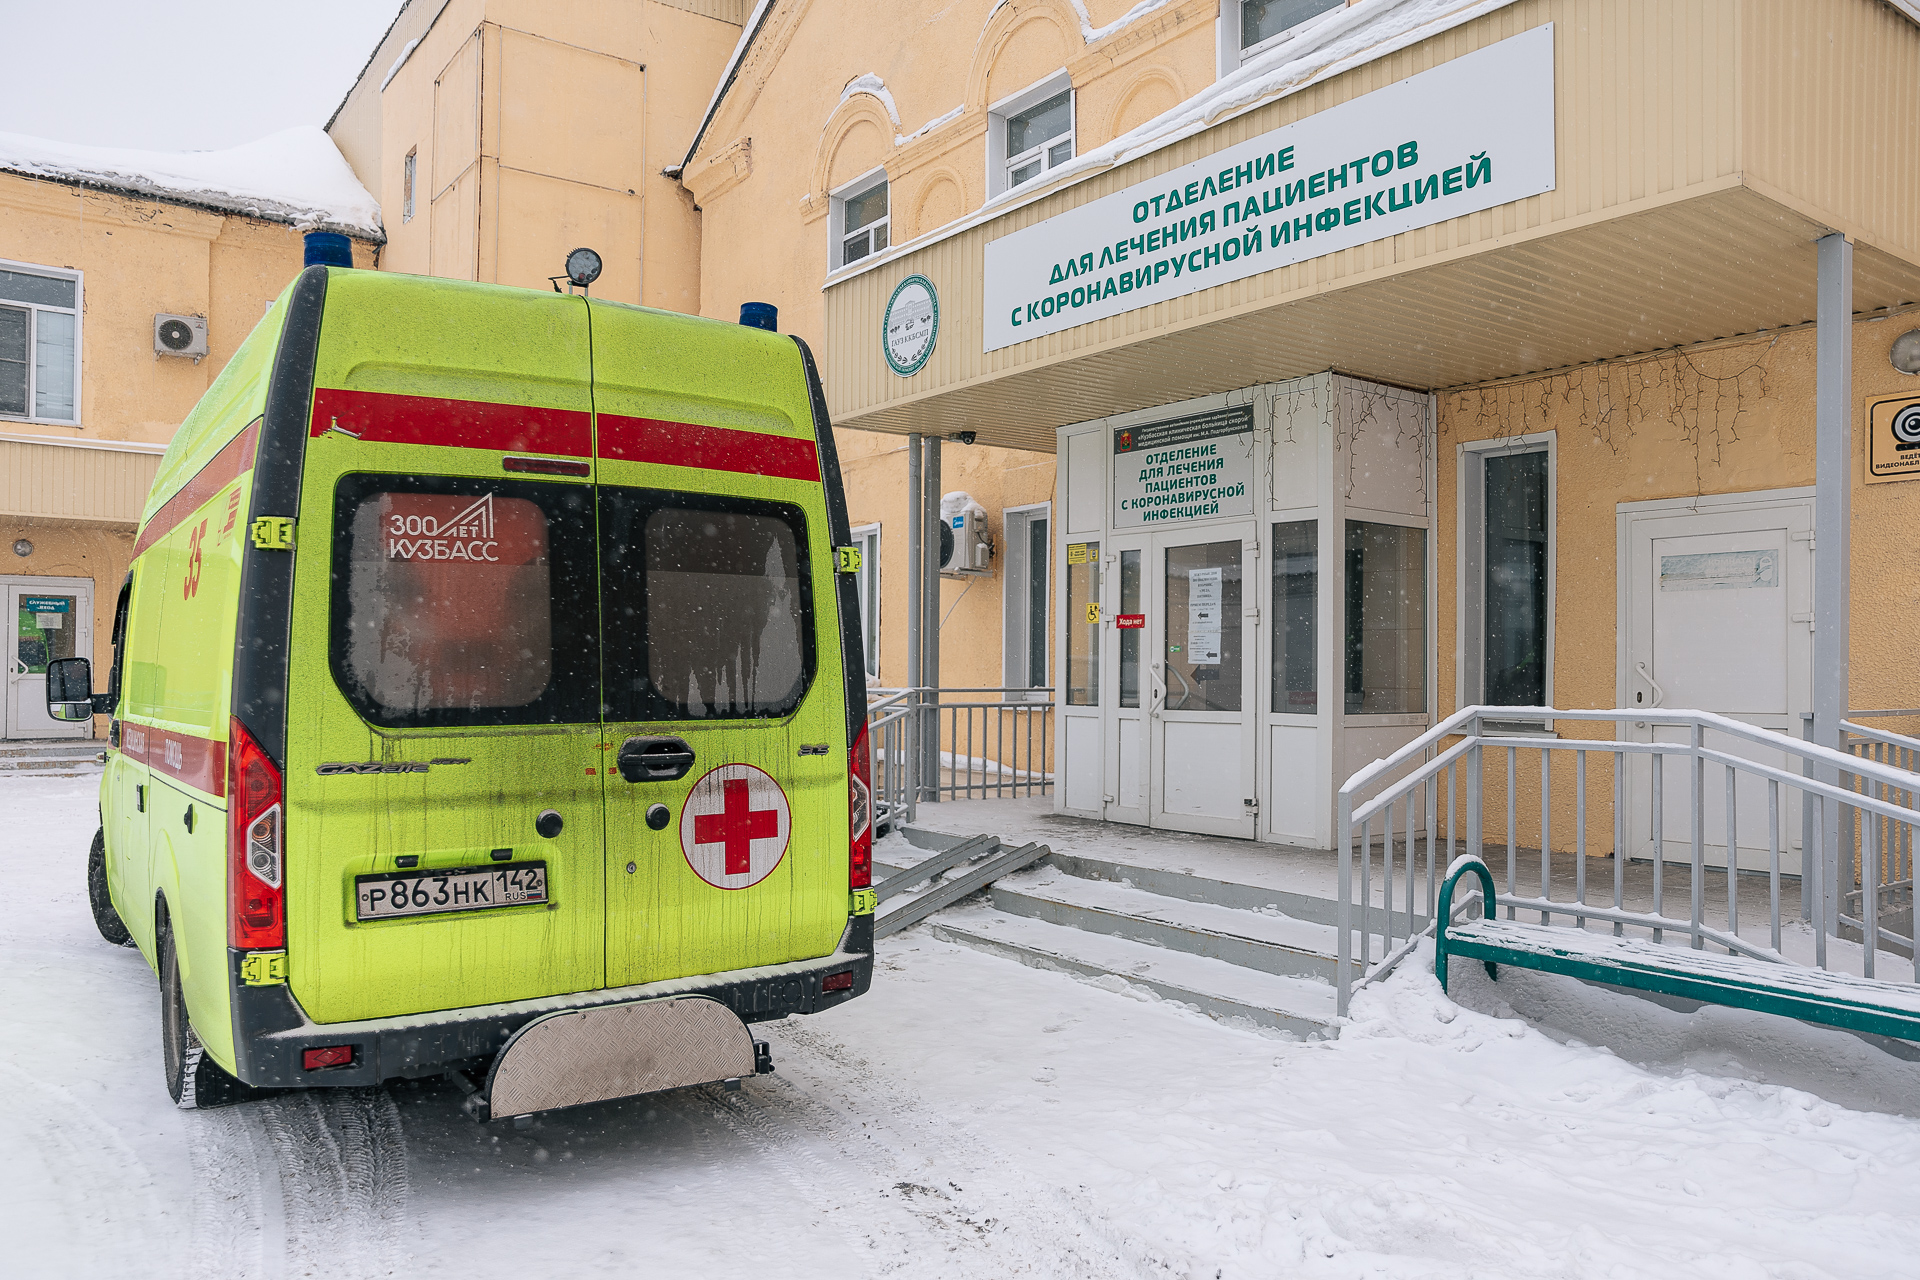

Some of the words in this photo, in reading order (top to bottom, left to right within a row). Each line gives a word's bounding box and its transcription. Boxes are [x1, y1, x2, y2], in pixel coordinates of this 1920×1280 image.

[1133, 145, 1295, 223] ОТДЕЛЕНИЕ
[1049, 250, 1094, 285] ДЛЯ
[1099, 210, 1215, 270] ЛЕЧЕНИЯ
[1223, 140, 1419, 223] ПАЦИЕНТОВ
[1011, 306, 1022, 327] С
[1027, 225, 1262, 320] КОРОНАВИРУСНОЙ
[1270, 151, 1492, 248] ИНФЕКЦИЕЙ
[1146, 444, 1217, 465] ОТДЕЛЕНИЕ
[1139, 467, 1163, 482] ДЛЯ
[1166, 458, 1224, 477] ЛЕЧЕНИЯ
[1145, 474, 1217, 493] ПАЦИЕНТОВ
[1121, 500, 1128, 510] С
[1131, 482, 1245, 509] КОРОНАВИРУСНОЙ
[1143, 500, 1219, 522] ИНФЕКЦИЕЙ
[390, 515, 438, 536] 300
[184, 517, 208, 601] 35
[390, 538, 499, 562] КУЗБАСС
[369, 877, 490, 911] Р863НК
[496, 869, 538, 892] 142
[506, 892, 526, 901] RUS
